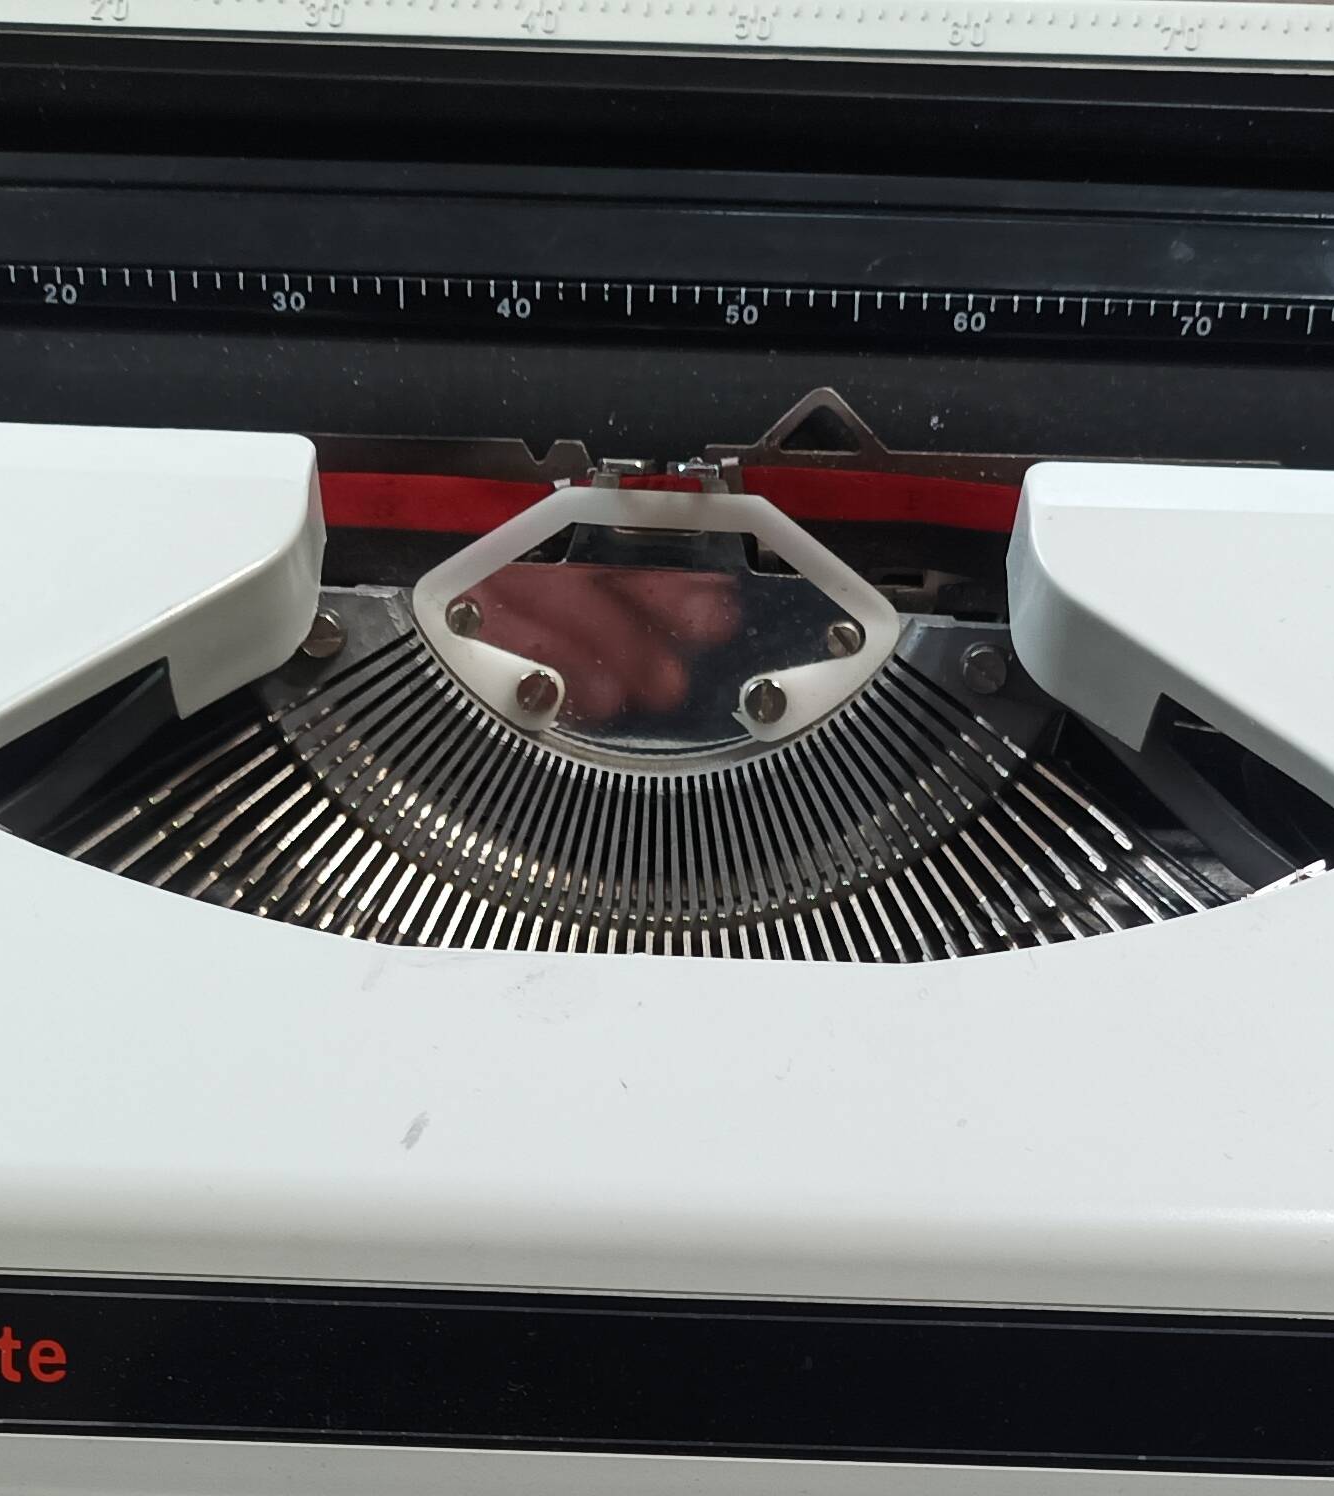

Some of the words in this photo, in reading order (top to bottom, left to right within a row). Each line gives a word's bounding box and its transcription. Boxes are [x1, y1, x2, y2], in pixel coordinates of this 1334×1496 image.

[88, 0, 129, 20] 20
[304, 3, 345, 28] 30
[520, 9, 559, 34] 40
[734, 15, 771, 41] 50
[948, 22, 986, 47] 60
[1161, 27, 1199, 52] 70
[45, 285, 77, 305] 20
[272, 291, 306, 312] 30
[496, 297, 531, 319] 40
[725, 304, 759, 325] 50
[953, 311, 986, 332] 60
[1180, 315, 1213, 337] 70
